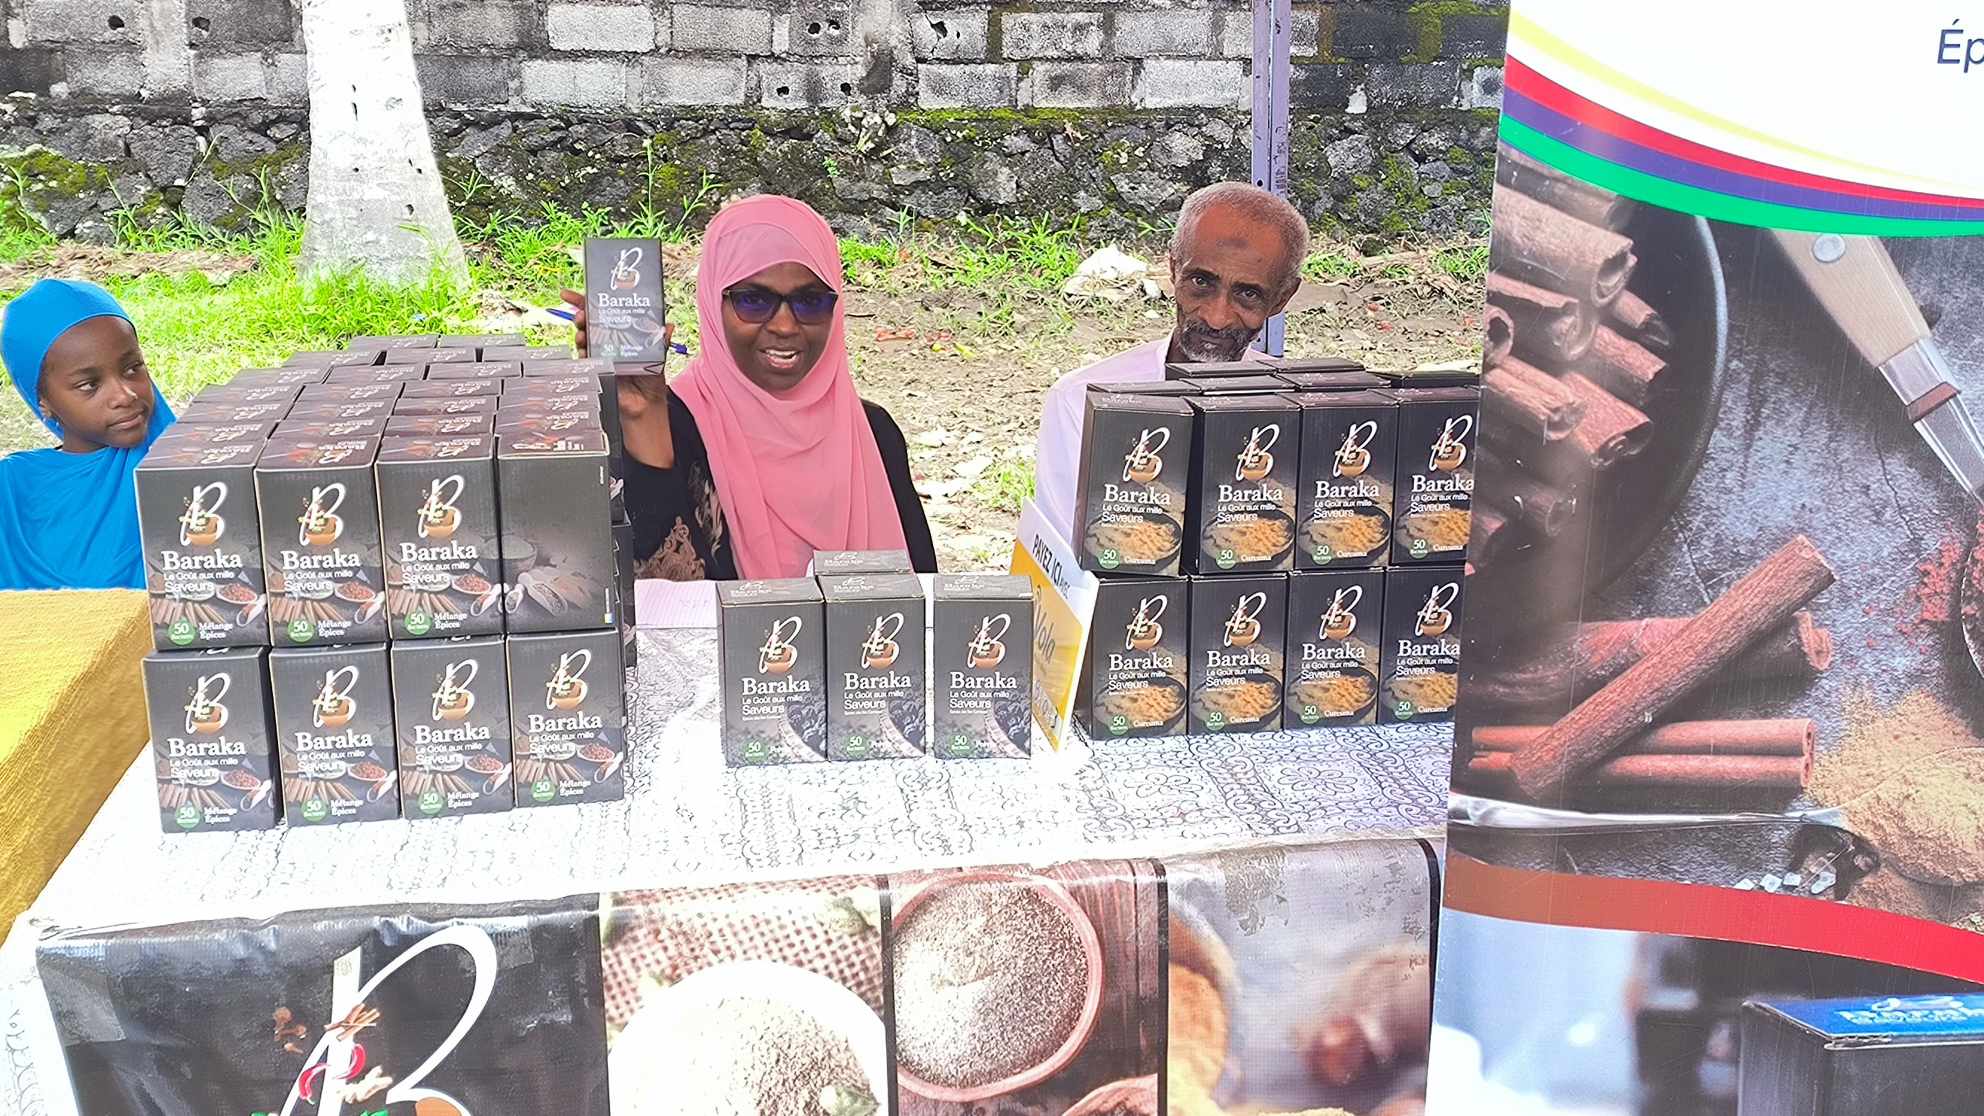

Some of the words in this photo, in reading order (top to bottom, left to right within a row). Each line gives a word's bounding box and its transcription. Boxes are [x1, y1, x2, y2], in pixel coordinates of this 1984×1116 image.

[598, 293, 651, 308] Baraka
[1315, 480, 1379, 498] Baraka
[1411, 475, 1474, 492] Baraka
[1103, 484, 1170, 505] Baraka
[1218, 484, 1283, 502] Baraka
[1410, 502, 1451, 512] Saveurs
[1101, 511, 1144, 523] Saveurs
[1217, 512, 1258, 522] Saveurs
[1313, 509, 1354, 519] Saveurs
[1317, 545, 1329, 555] 50
[1413, 539, 1426, 549] 50
[399, 540, 478, 562] Baraka
[1103, 550, 1116, 560] 50
[1220, 550, 1233, 560] 50
[161, 549, 243, 571] Baraka
[280, 548, 361, 570] Baraka
[1032, 533, 1053, 574] PAYEZ
[1050, 558, 1063, 587] ICI
[402, 572, 450, 584] Saveurs
[164, 580, 215, 592] Saveurs
[284, 580, 334, 592] Saveurs
[409, 613, 424, 624] 50
[174, 622, 189, 634] 50
[293, 621, 308, 632] 50
[1302, 642, 1366, 660] Baraka
[1397, 638, 1460, 656] Baraka
[1109, 652, 1173, 671] Baraka
[1206, 649, 1271, 667] Baraka
[1300, 670, 1341, 680] Saveurs
[1396, 665, 1436, 676] Saveurs
[741, 675, 810, 696] Baraka
[844, 670, 911, 690] Baraka
[949, 671, 1017, 689] Baraka
[1108, 680, 1148, 690] Saveurs
[1205, 677, 1246, 687] Saveurs
[742, 704, 785, 715] Saveurs
[844, 699, 886, 710] Saveurs
[949, 699, 992, 709] Saveurs
[1304, 705, 1317, 715] 50
[1398, 701, 1410, 711] 50
[528, 711, 603, 733] Baraka
[1113, 716, 1125, 726] 50
[1210, 712, 1222, 722] 50
[414, 721, 491, 744] Baraka
[294, 728, 373, 751] Baraka
[849, 736, 862, 746] 50
[954, 735, 967, 745] 50
[167, 736, 247, 757] Baraka
[749, 741, 762, 753] 50
[536, 781, 550, 792] 50
[423, 793, 437, 803] 50
[307, 799, 321, 810] 50
[179, 807, 195, 819] 50
